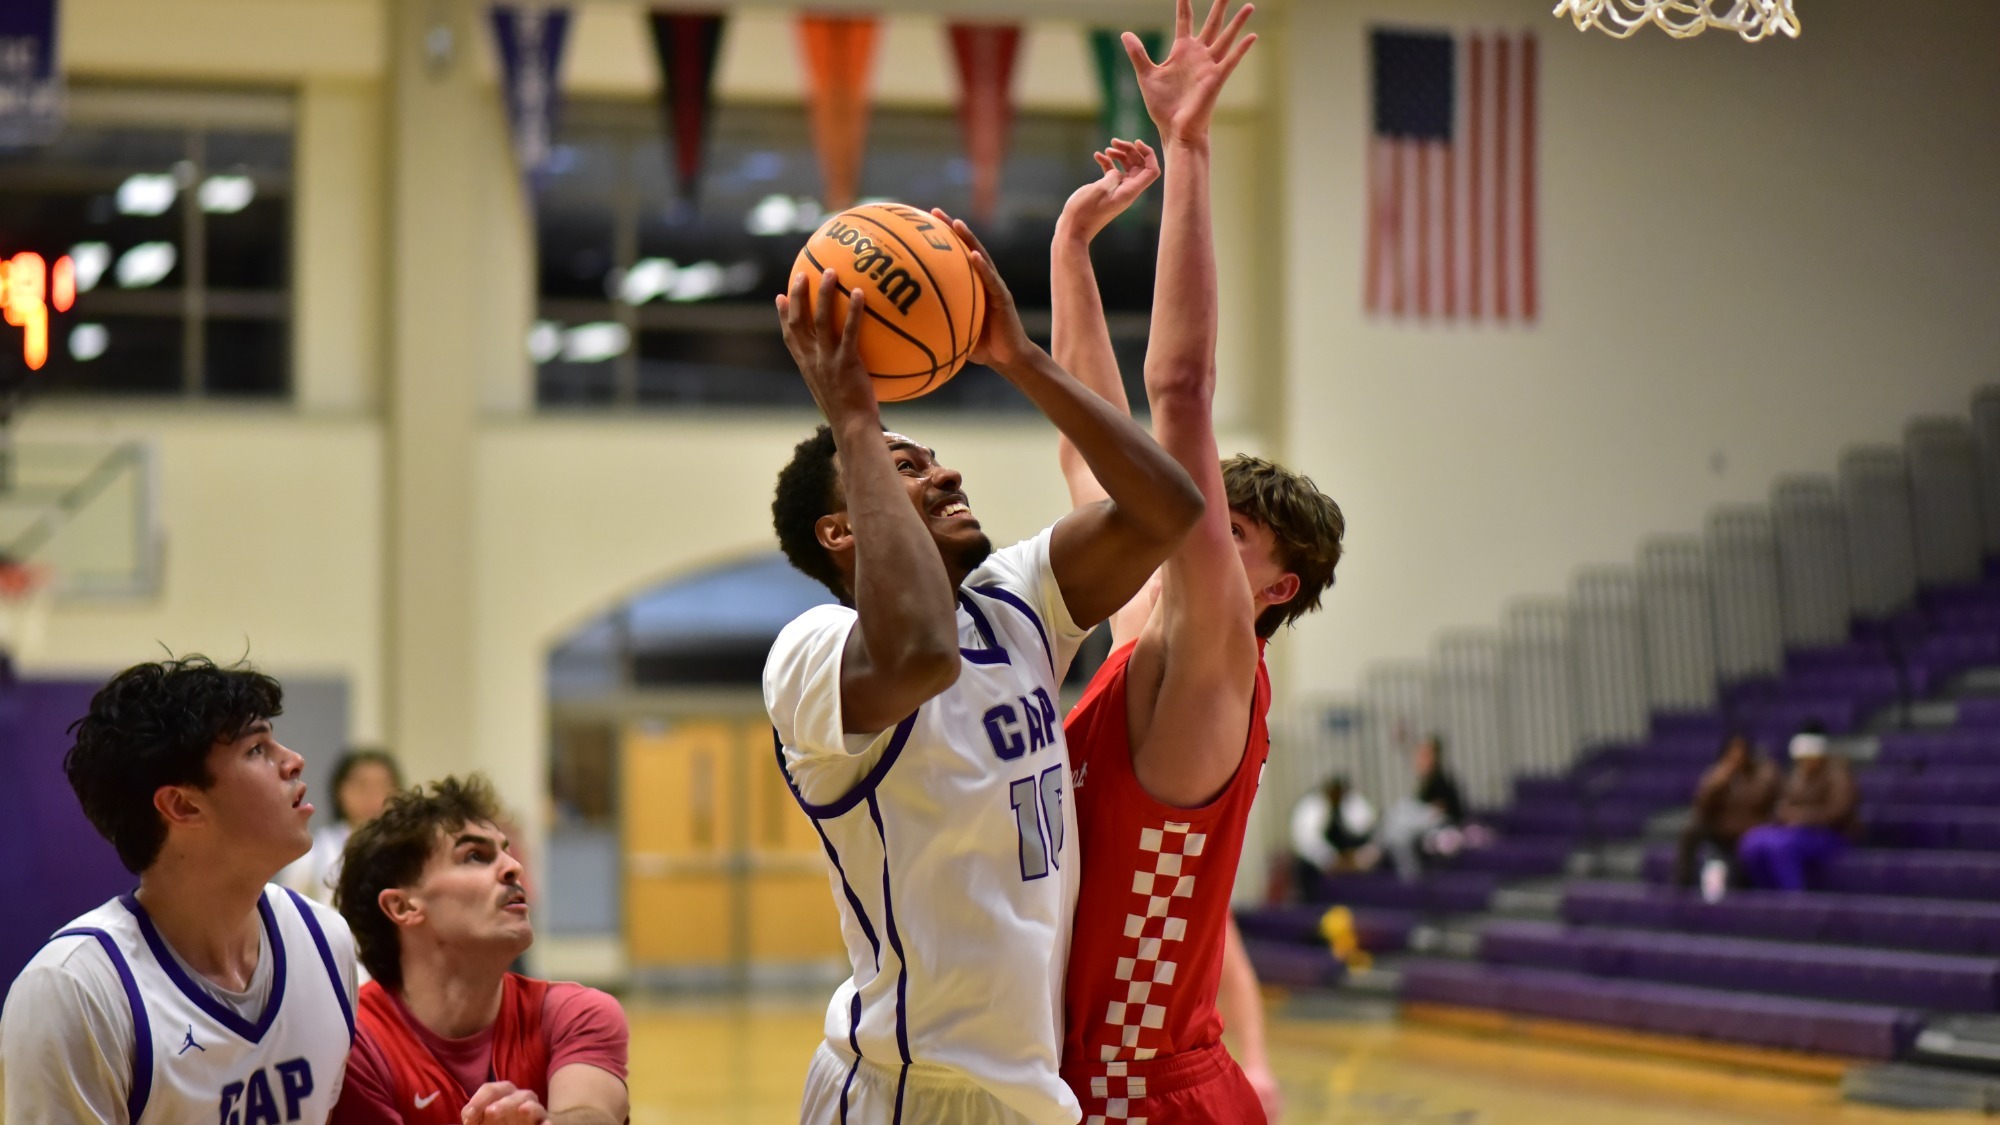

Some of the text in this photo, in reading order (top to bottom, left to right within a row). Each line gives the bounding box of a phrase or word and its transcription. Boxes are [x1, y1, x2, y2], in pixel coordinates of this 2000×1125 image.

[826, 221, 922, 316] Wilson
[981, 685, 1057, 763] CAP
[219, 1056, 315, 1125] CAP
